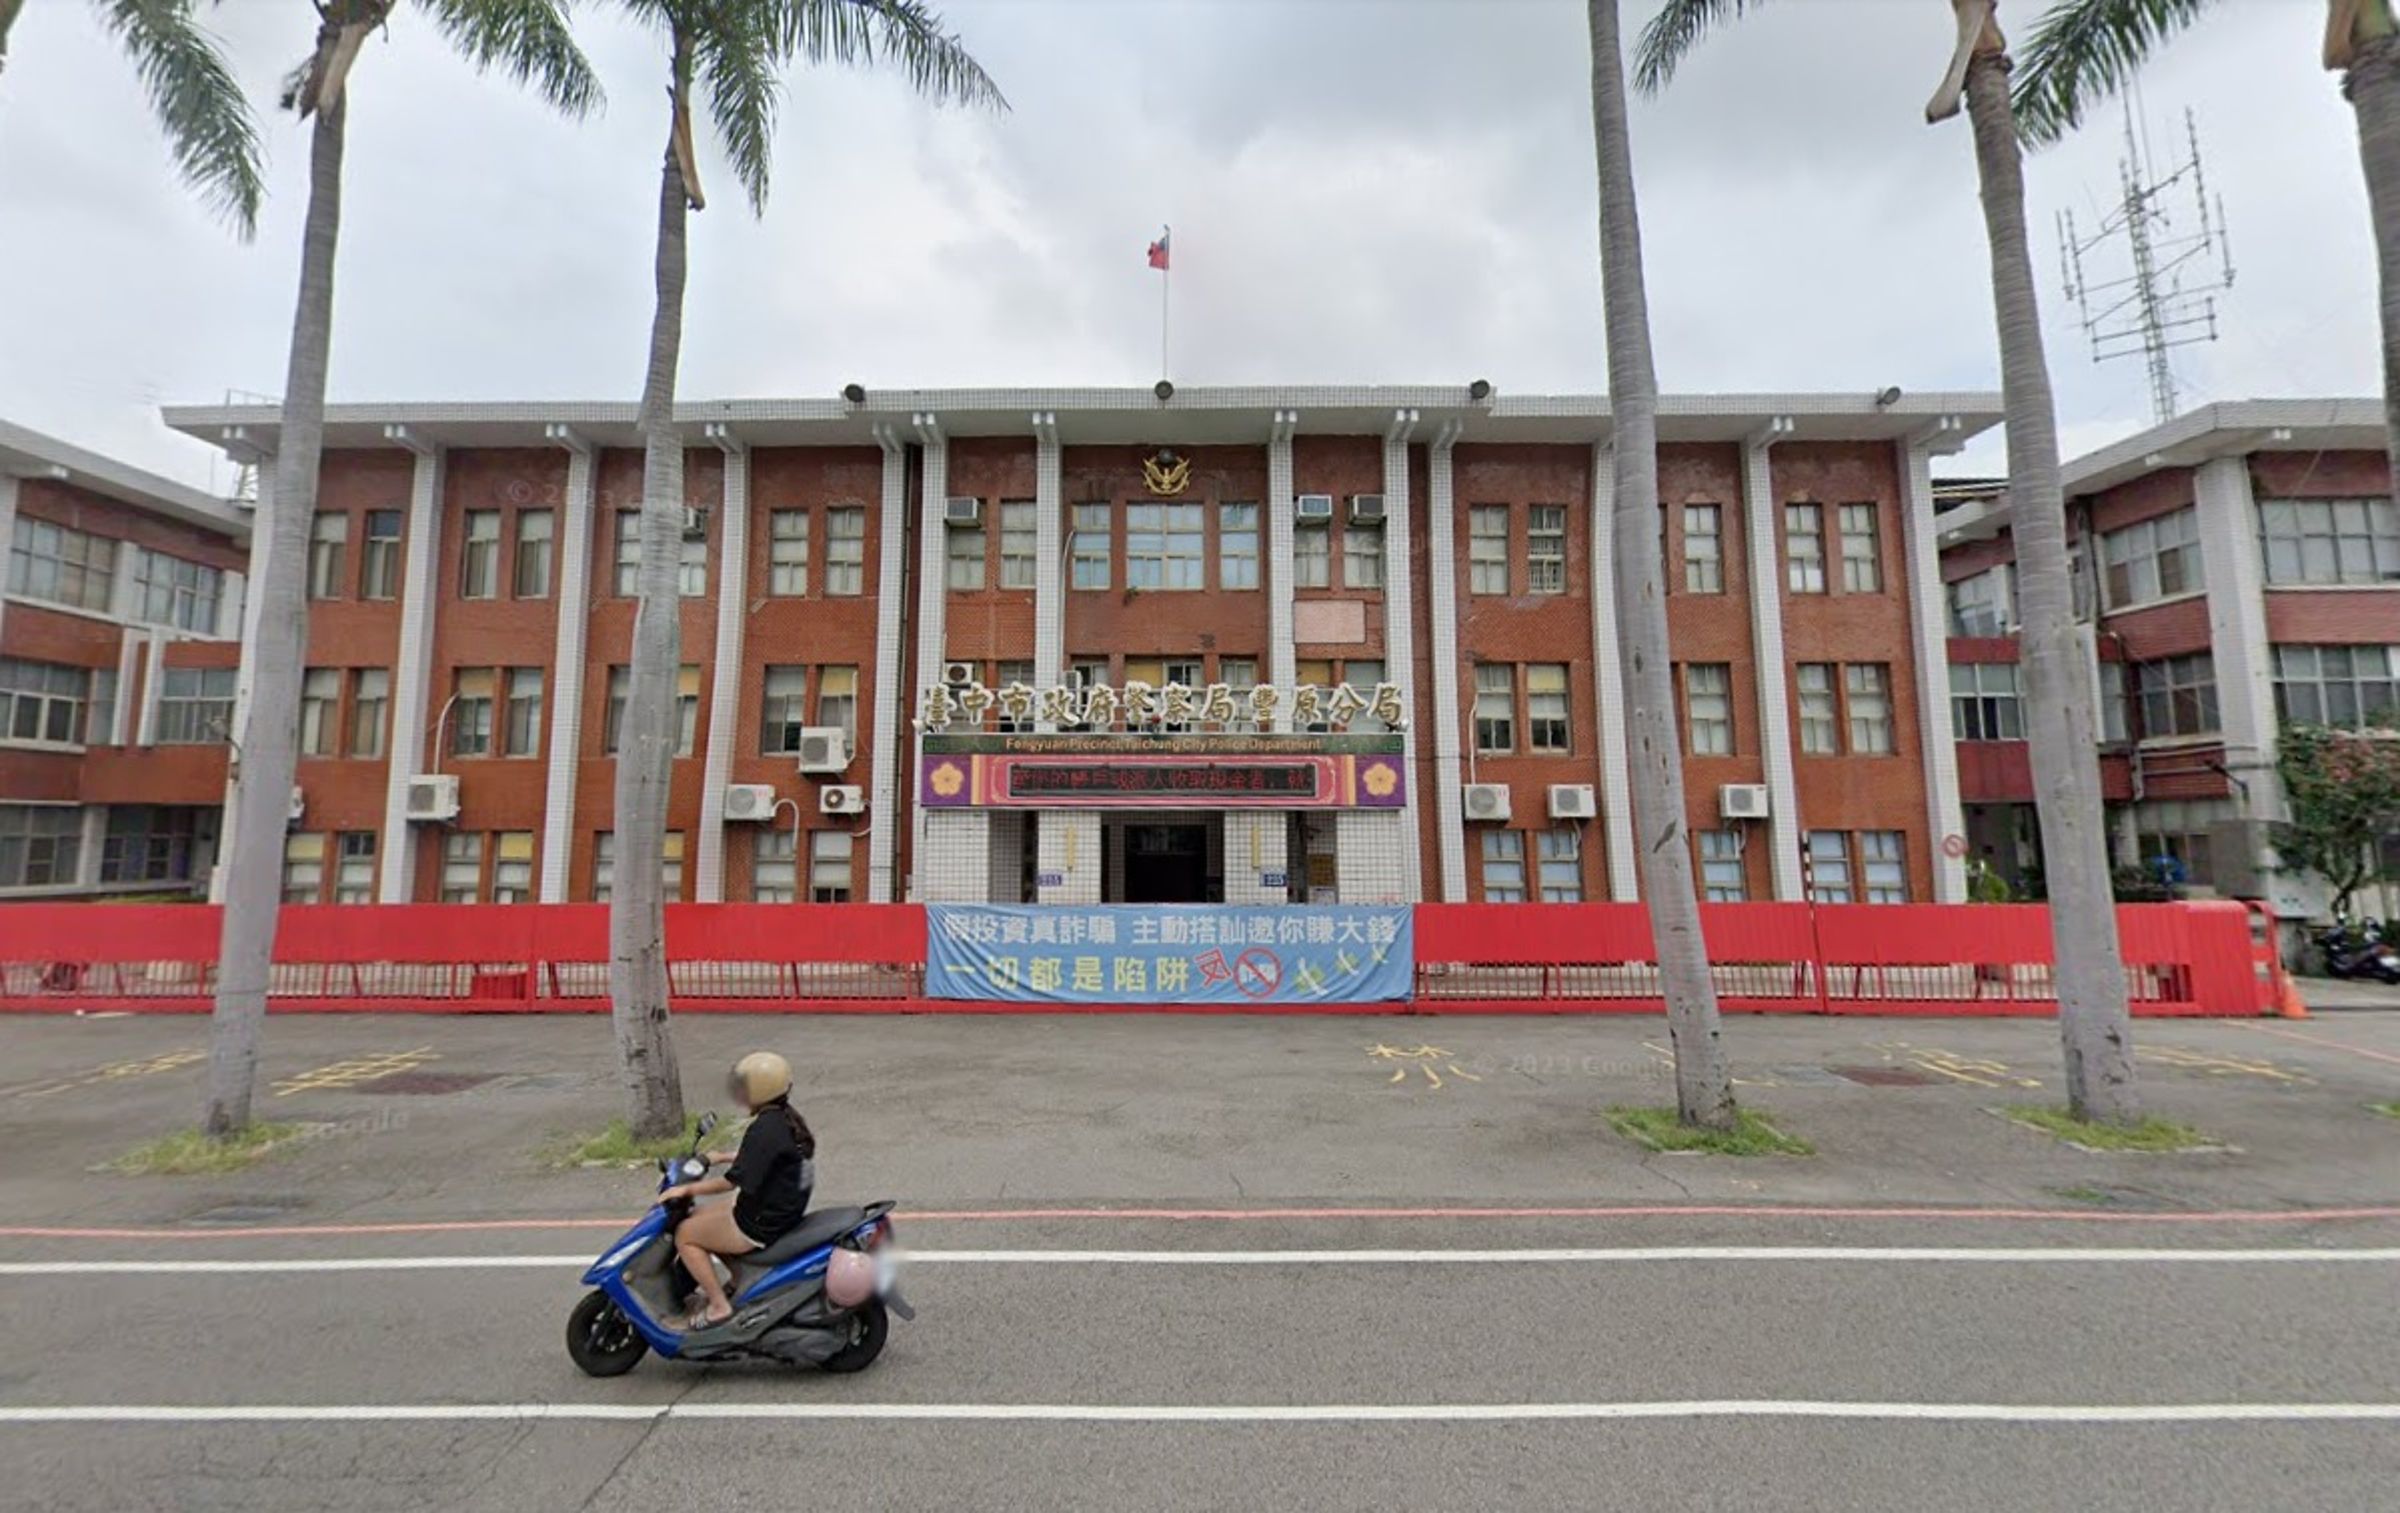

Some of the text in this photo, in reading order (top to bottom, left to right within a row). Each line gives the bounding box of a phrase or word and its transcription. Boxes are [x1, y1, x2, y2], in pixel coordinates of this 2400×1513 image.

[925, 681, 1403, 727] 臺中市政府警察局豐原分局
[1006, 738, 1066, 753] Fengyuan
[1125, 738, 1180, 753] Taichung
[1182, 738, 1206, 753] City
[1208, 738, 1247, 752] Police
[1249, 738, 1321, 753] Department
[1132, 914, 1397, 944] 主動搭訕邀你賺大錢
[945, 955, 1190, 993] 一切都是陷阱
